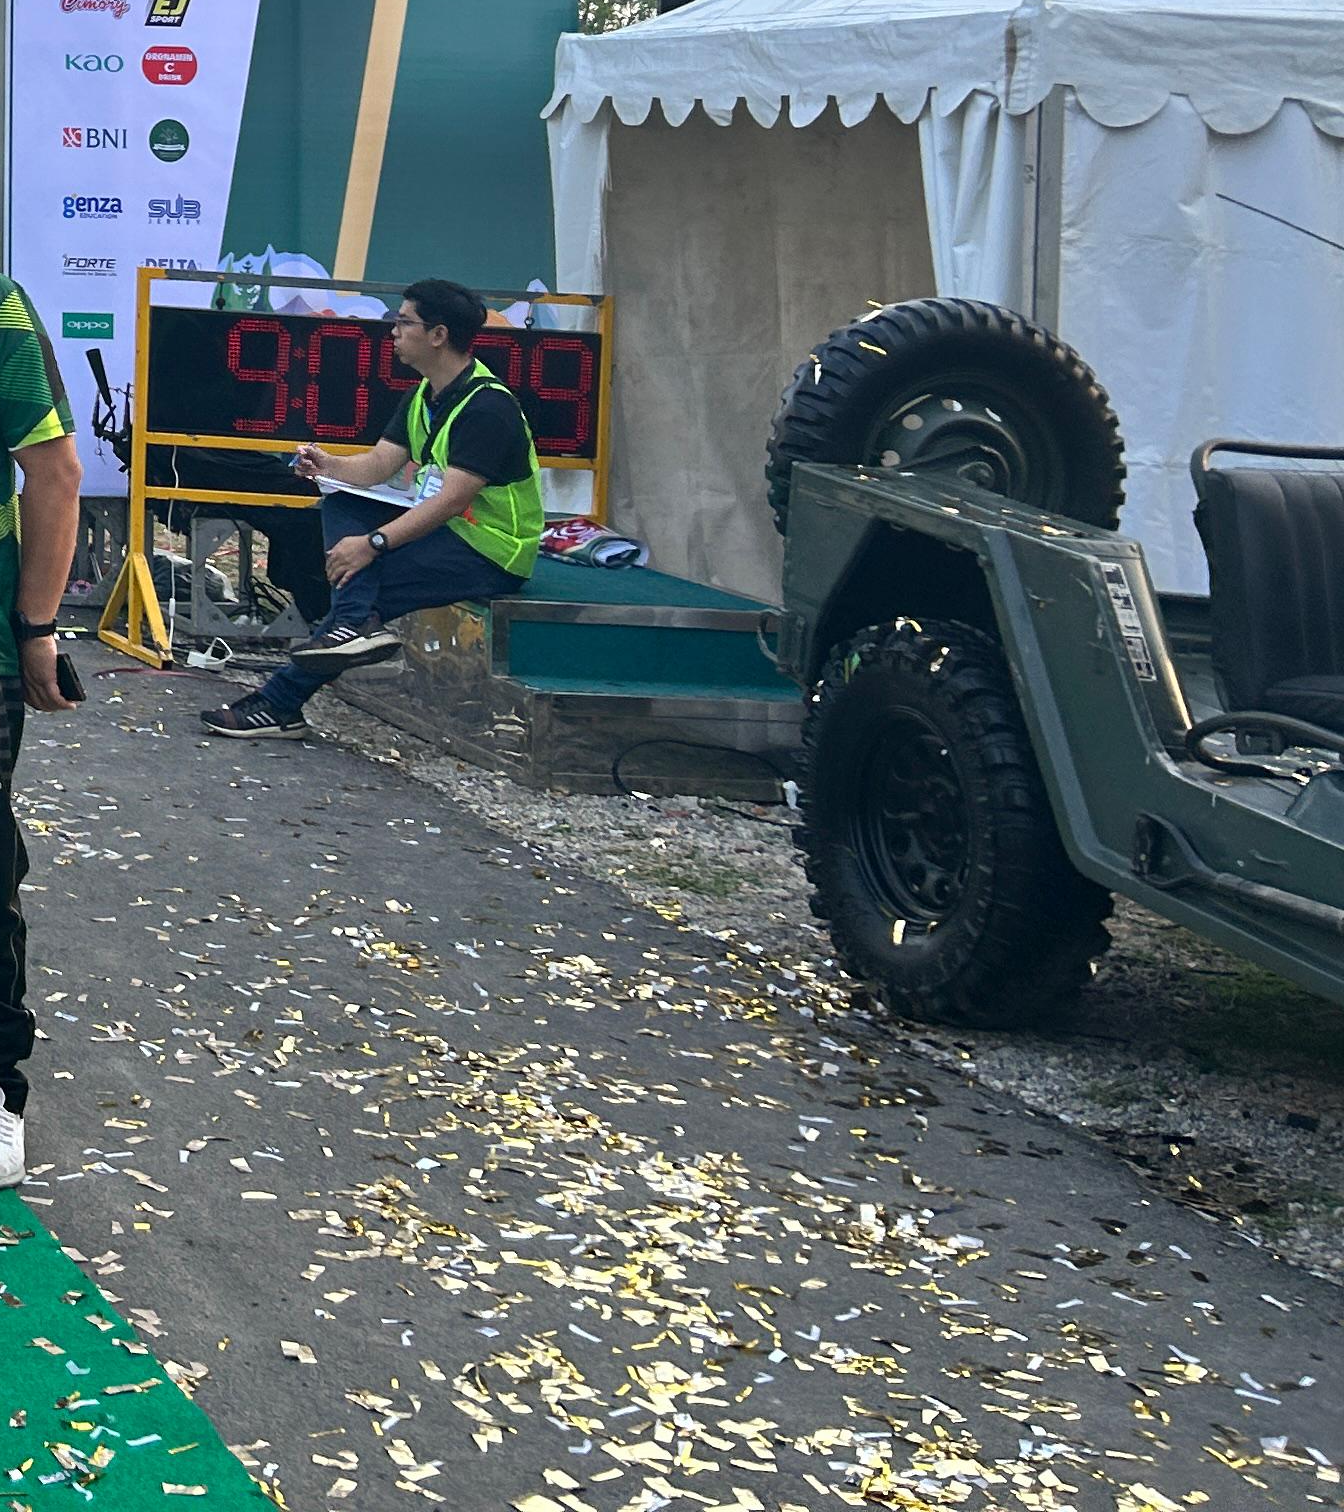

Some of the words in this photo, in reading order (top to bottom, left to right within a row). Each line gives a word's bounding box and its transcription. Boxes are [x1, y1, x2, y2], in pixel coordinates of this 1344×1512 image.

[149, 15, 181, 24] SPORT
[164, 62, 175, 72] C
[86, 128, 127, 149] BNI
[62, 195, 123, 218] genza
[148, 196, 201, 219] SUB
